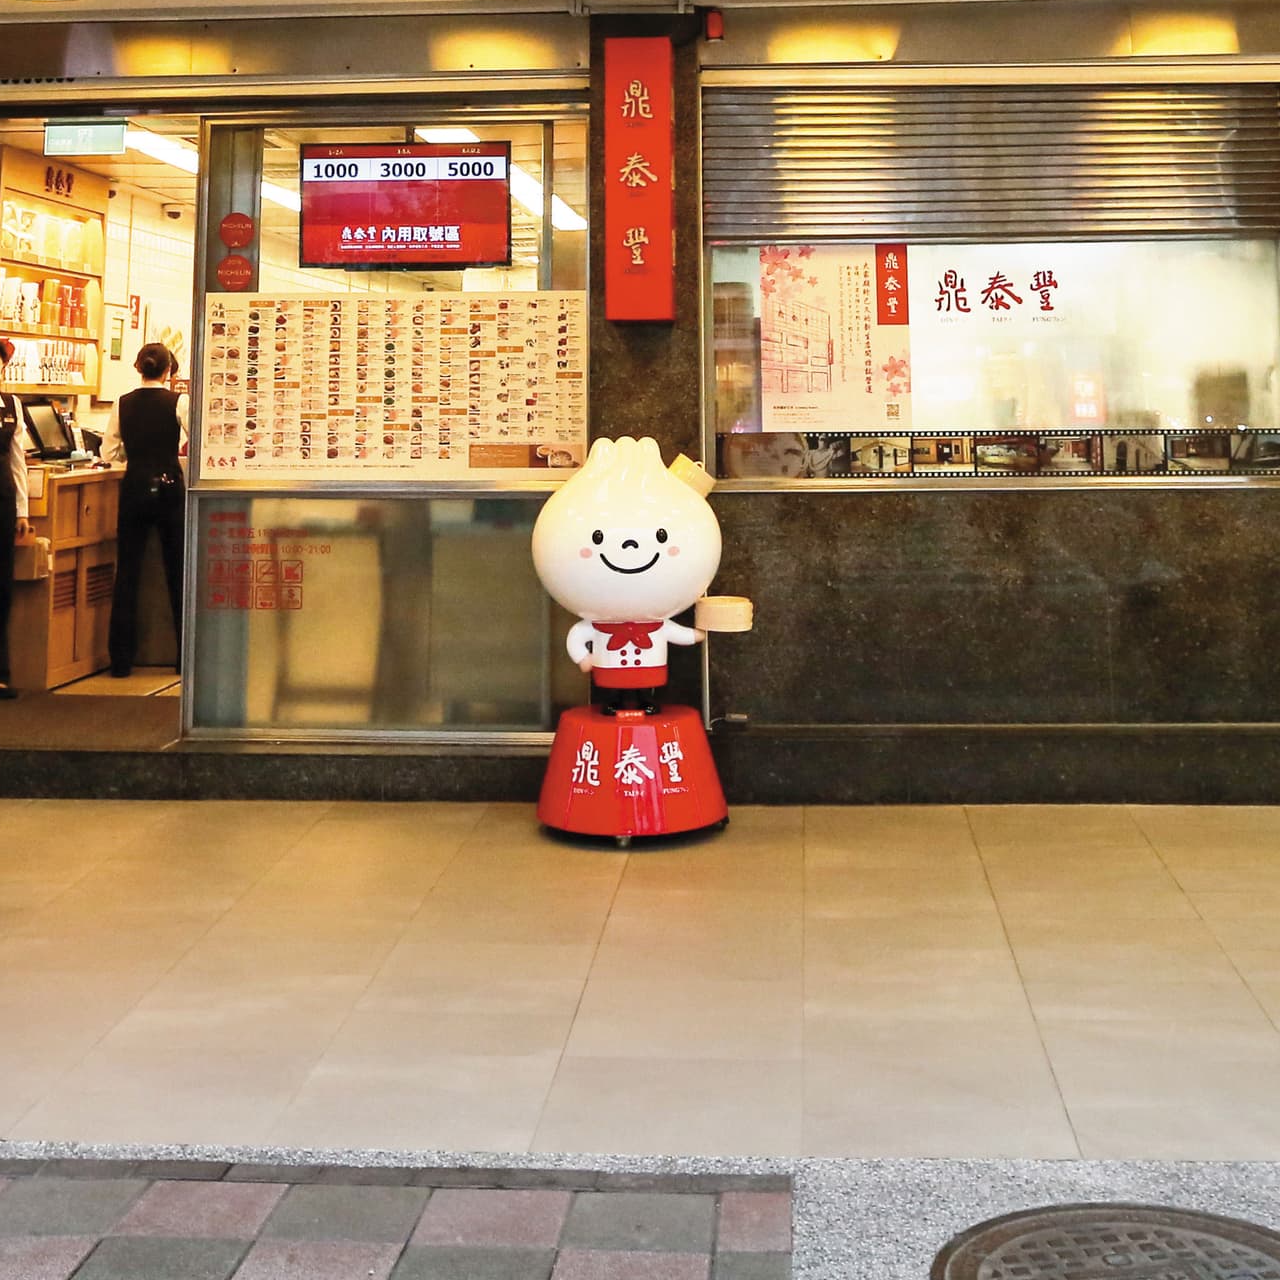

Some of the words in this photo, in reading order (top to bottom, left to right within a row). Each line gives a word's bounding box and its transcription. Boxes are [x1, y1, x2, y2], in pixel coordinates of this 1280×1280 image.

[313, 163, 359, 178] 1000
[380, 162, 426, 177] 3000
[448, 161, 494, 177] 5000
[620, 80, 658, 264] 鼎泰豐
[381, 225, 460, 242] 內用取號區
[935, 270, 1059, 313] 鼎泰豐
[572, 741, 684, 786] 鼎泰豐
